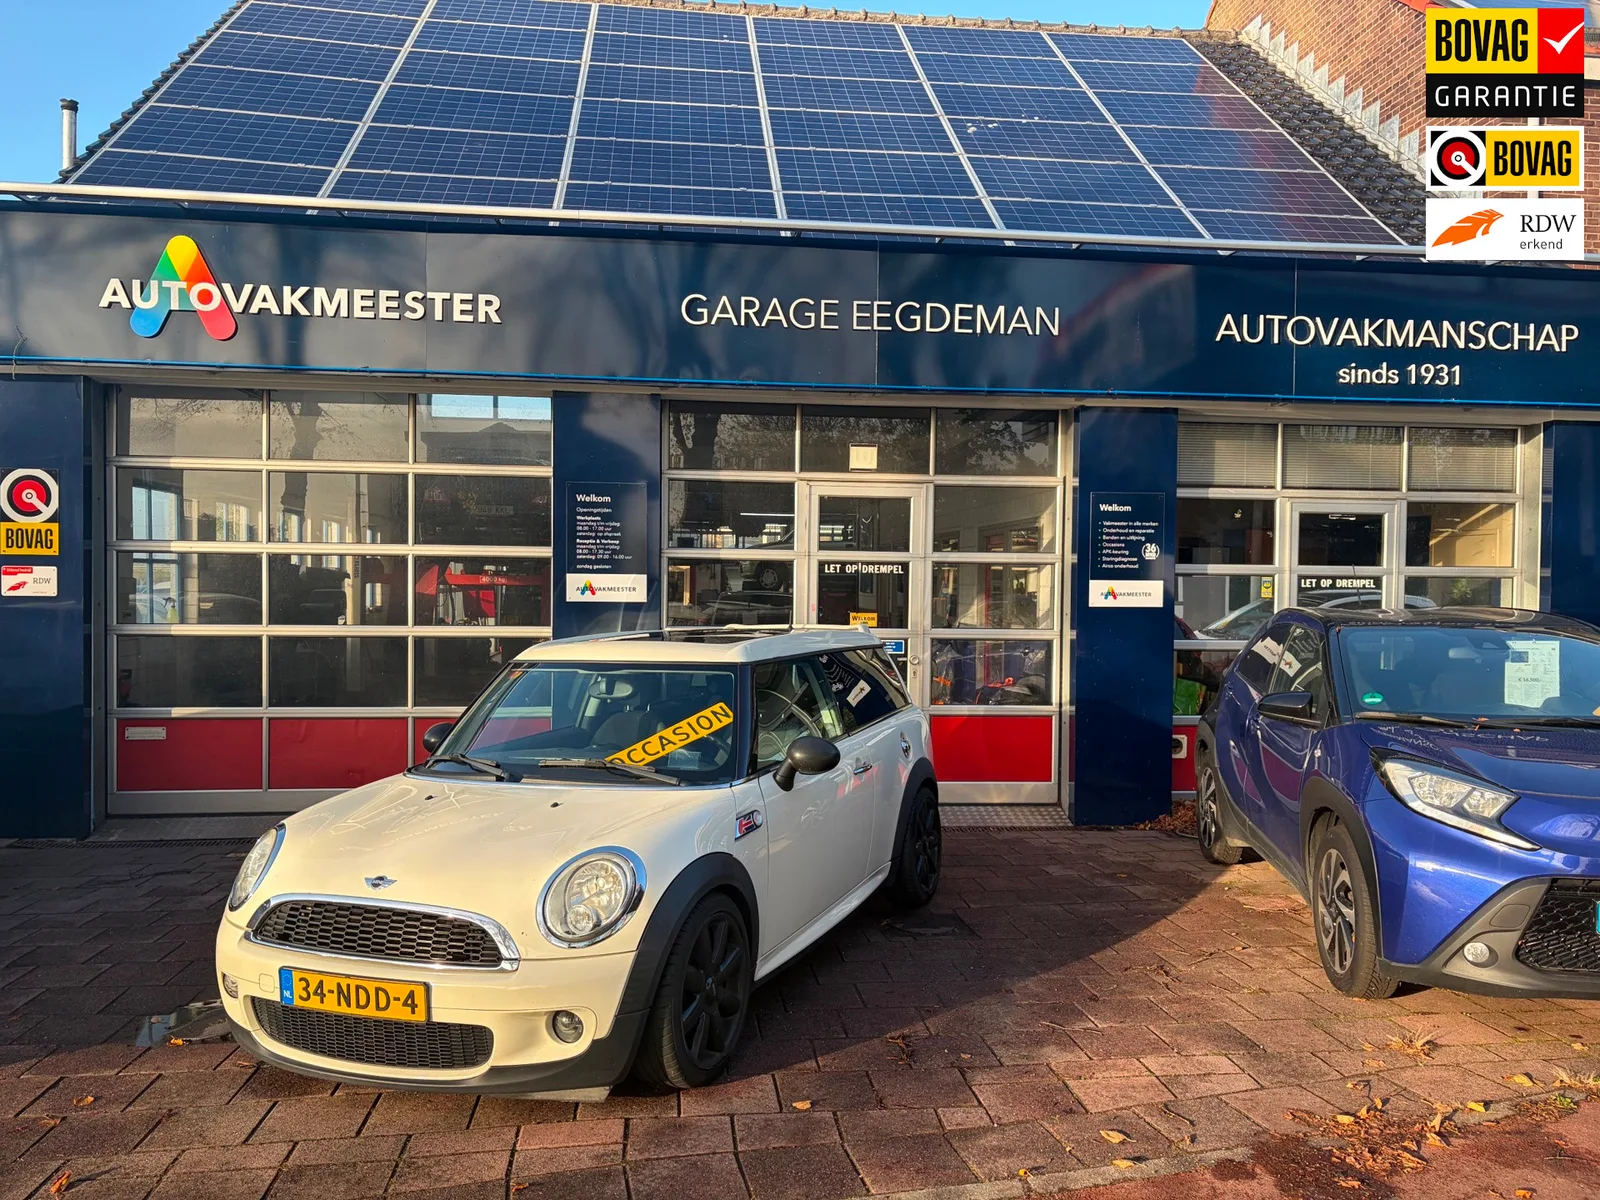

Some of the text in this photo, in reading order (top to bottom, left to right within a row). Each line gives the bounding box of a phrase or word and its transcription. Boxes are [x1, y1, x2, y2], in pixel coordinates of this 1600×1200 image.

[99, 278, 502, 324] AUTOVAKMEESTER
[681, 293, 1060, 337] GARAGE EEGDEMAN
[1215, 313, 1580, 352] AUTOVAKMANSCHAP
[1338, 363, 1461, 386] sinds 1931
[576, 494, 611, 502] Welkom
[6, 528, 53, 550] BOVAG
[824, 563, 904, 574] LET OP DREMPEL
[32, 577, 52, 585] RDW
[1301, 579, 1376, 588] LET OP DREMPEL
[283, 990, 293, 999] NL
[298, 977, 418, 1015] 34-NDD-4
